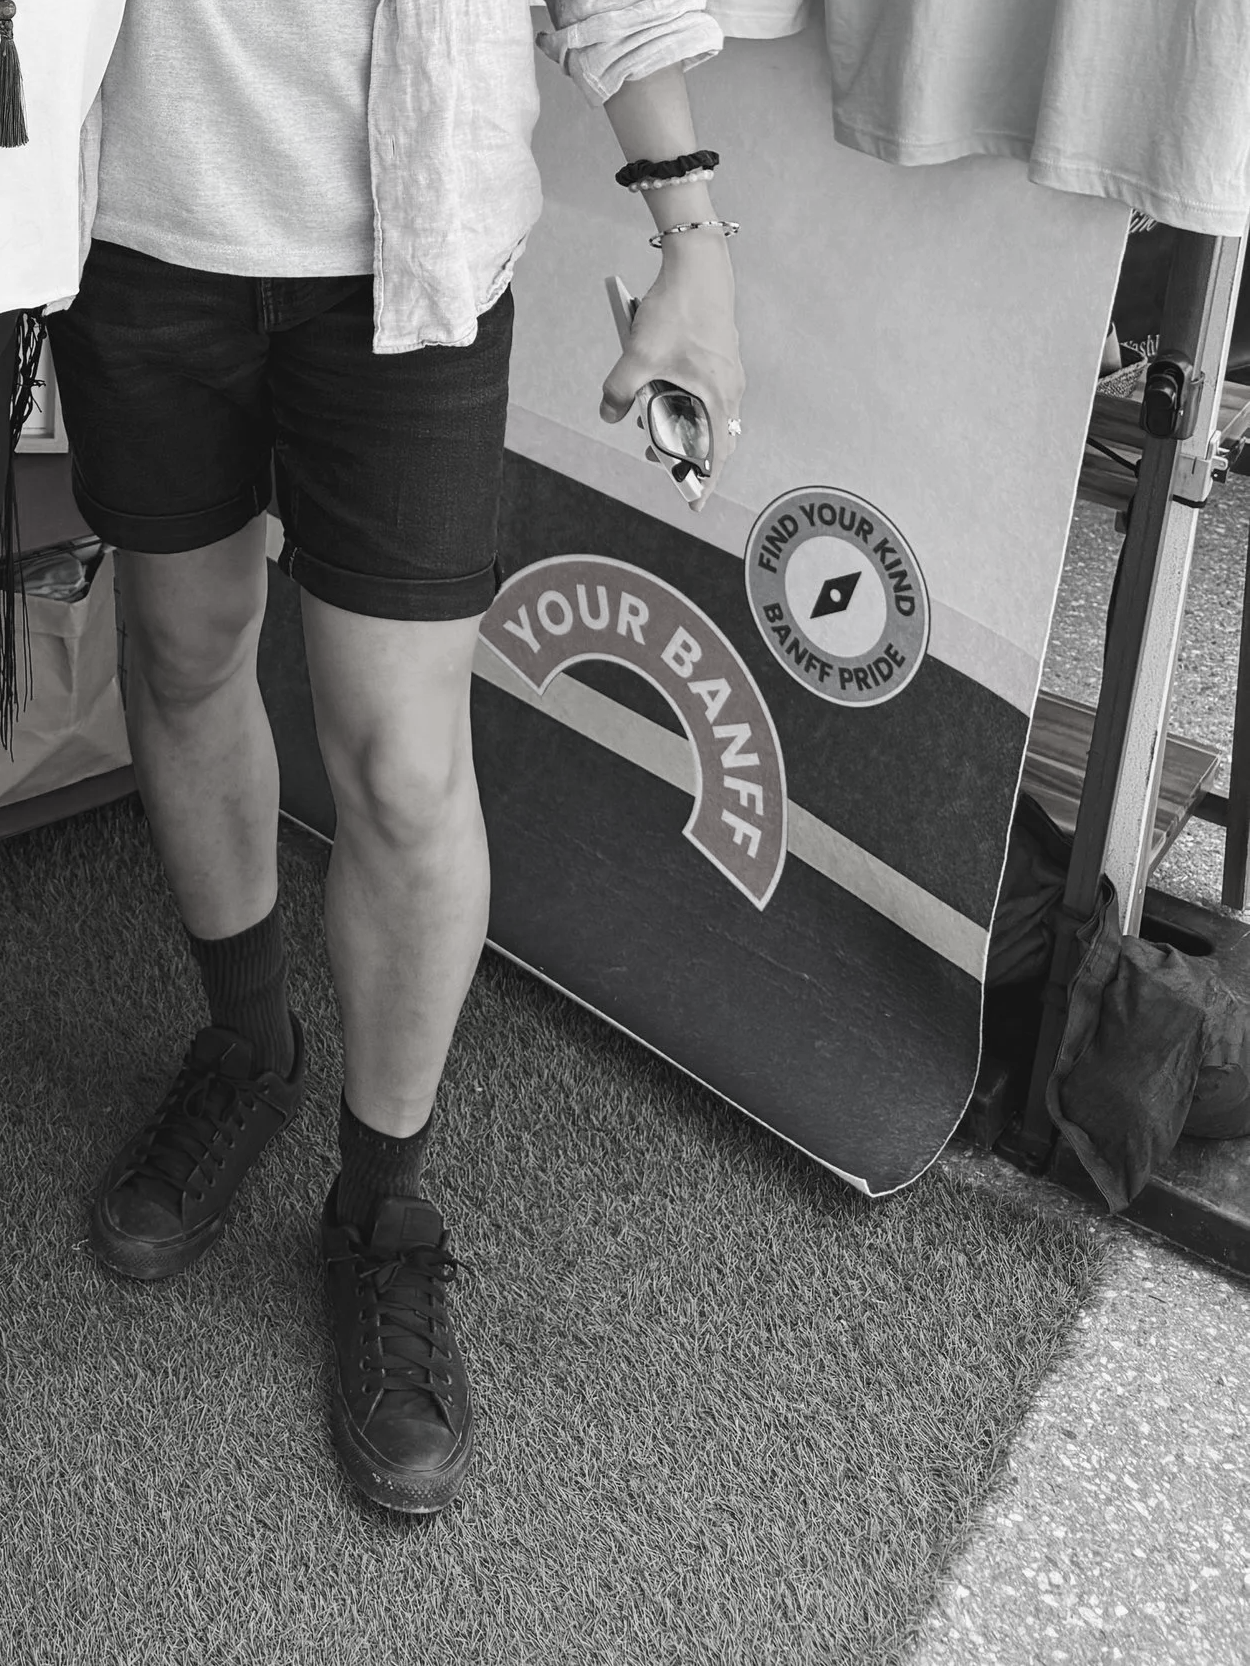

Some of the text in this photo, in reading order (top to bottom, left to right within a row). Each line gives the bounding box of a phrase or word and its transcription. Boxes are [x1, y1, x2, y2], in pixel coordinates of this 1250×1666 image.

[757, 502, 916, 617] FIND YOUR KIND
[763, 602, 906, 691] BANFF PRIDE
[502, 583, 765, 859] YOUR BANFF
